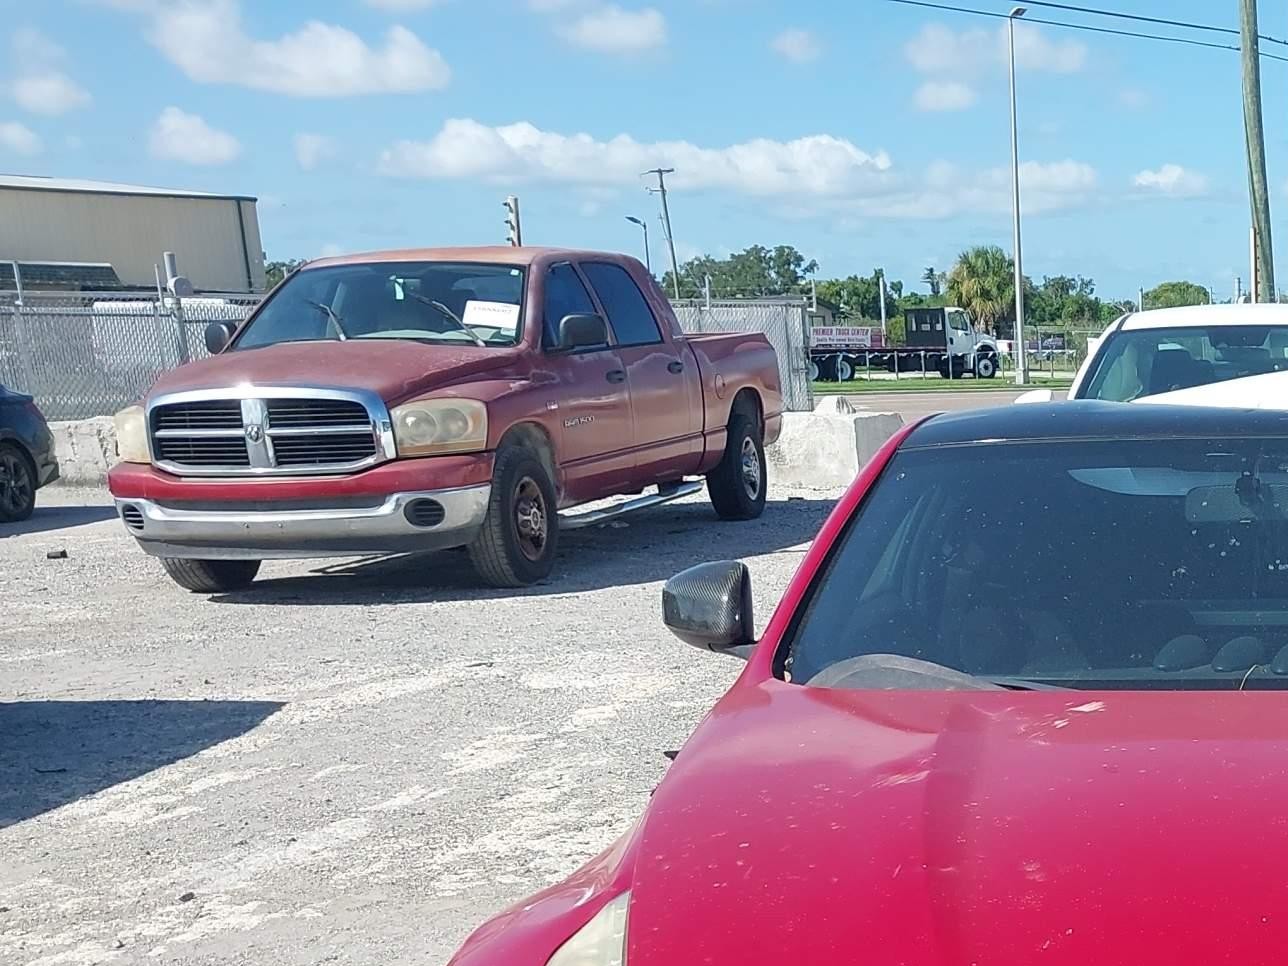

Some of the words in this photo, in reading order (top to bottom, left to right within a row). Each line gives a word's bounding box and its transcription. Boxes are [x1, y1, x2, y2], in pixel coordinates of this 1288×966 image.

[812, 328, 833, 336] PREMIER
[835, 328, 850, 336] TRUCK
[851, 328, 869, 336] CENTER
